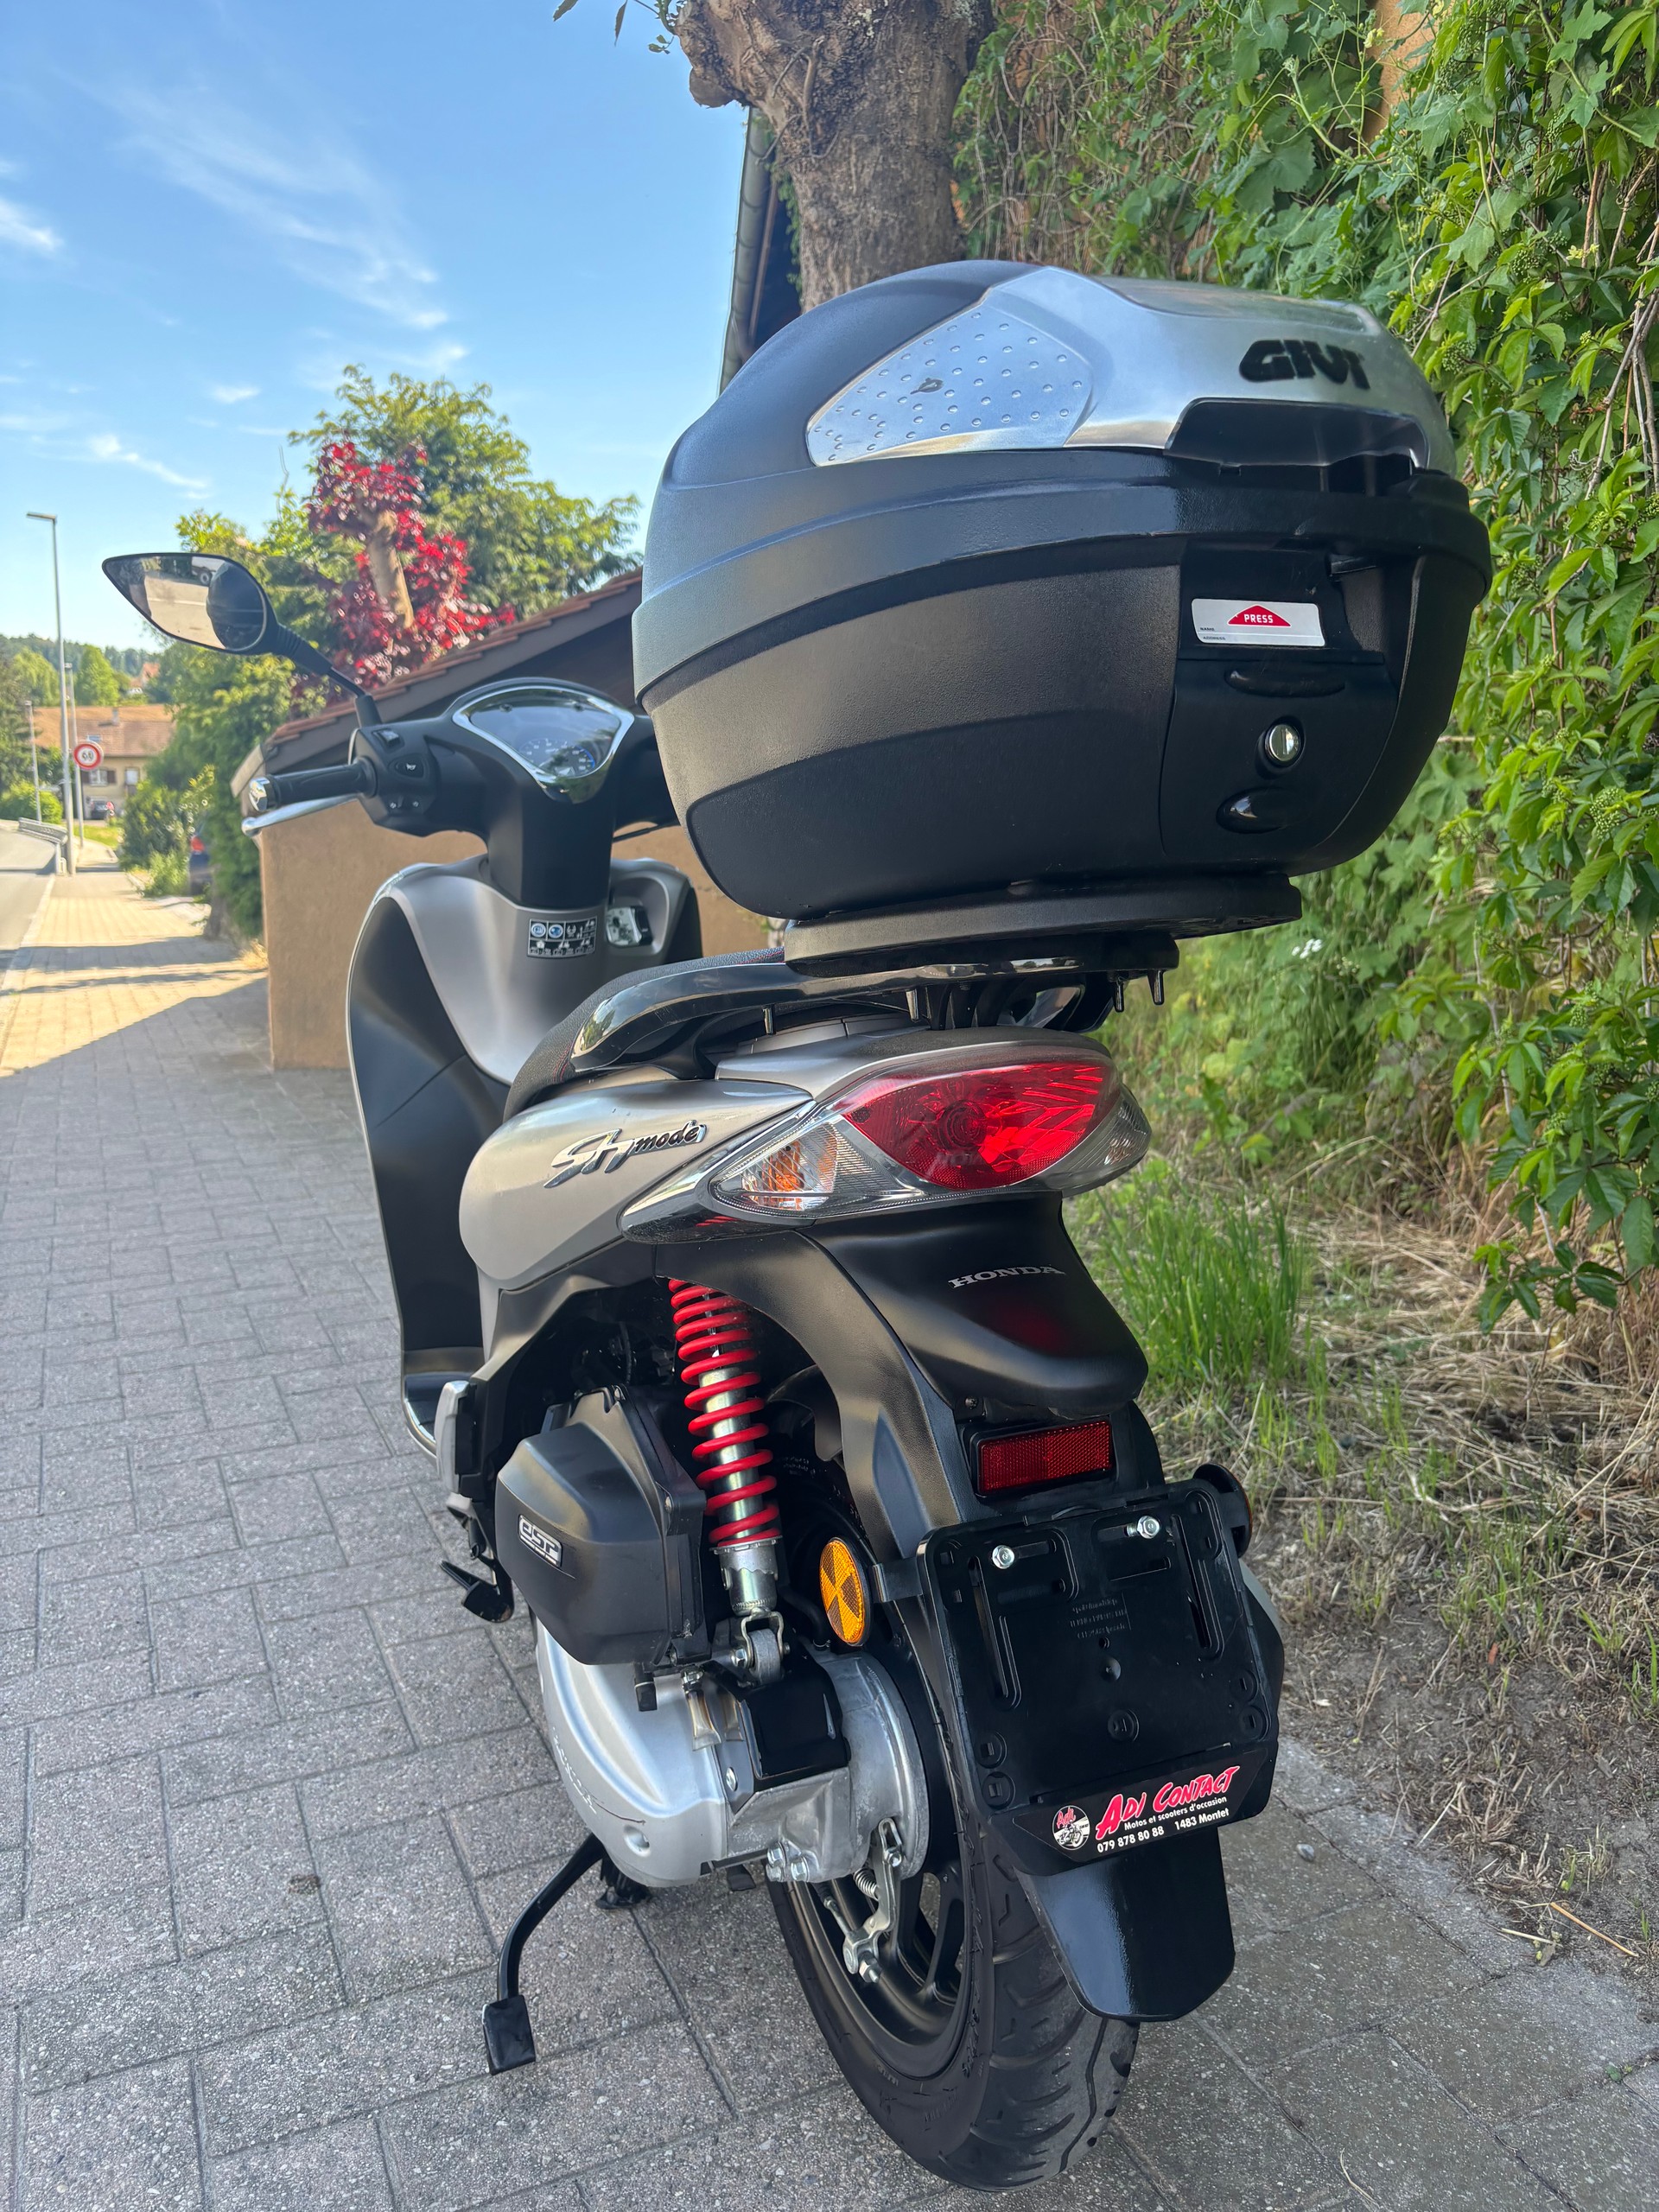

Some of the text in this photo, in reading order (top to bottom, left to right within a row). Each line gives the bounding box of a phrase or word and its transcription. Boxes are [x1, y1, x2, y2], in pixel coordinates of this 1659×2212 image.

[1239, 340, 1370, 389] GIVI
[1243, 613, 1274, 624] PRESS
[632, 1120, 699, 1154] mode
[948, 1266, 1065, 1288] HONDA
[1096, 1808, 1230, 1853] 079 878 80 88 1483 Montet
[1124, 1796, 1227, 1831] Motos et scooters d'occasion
